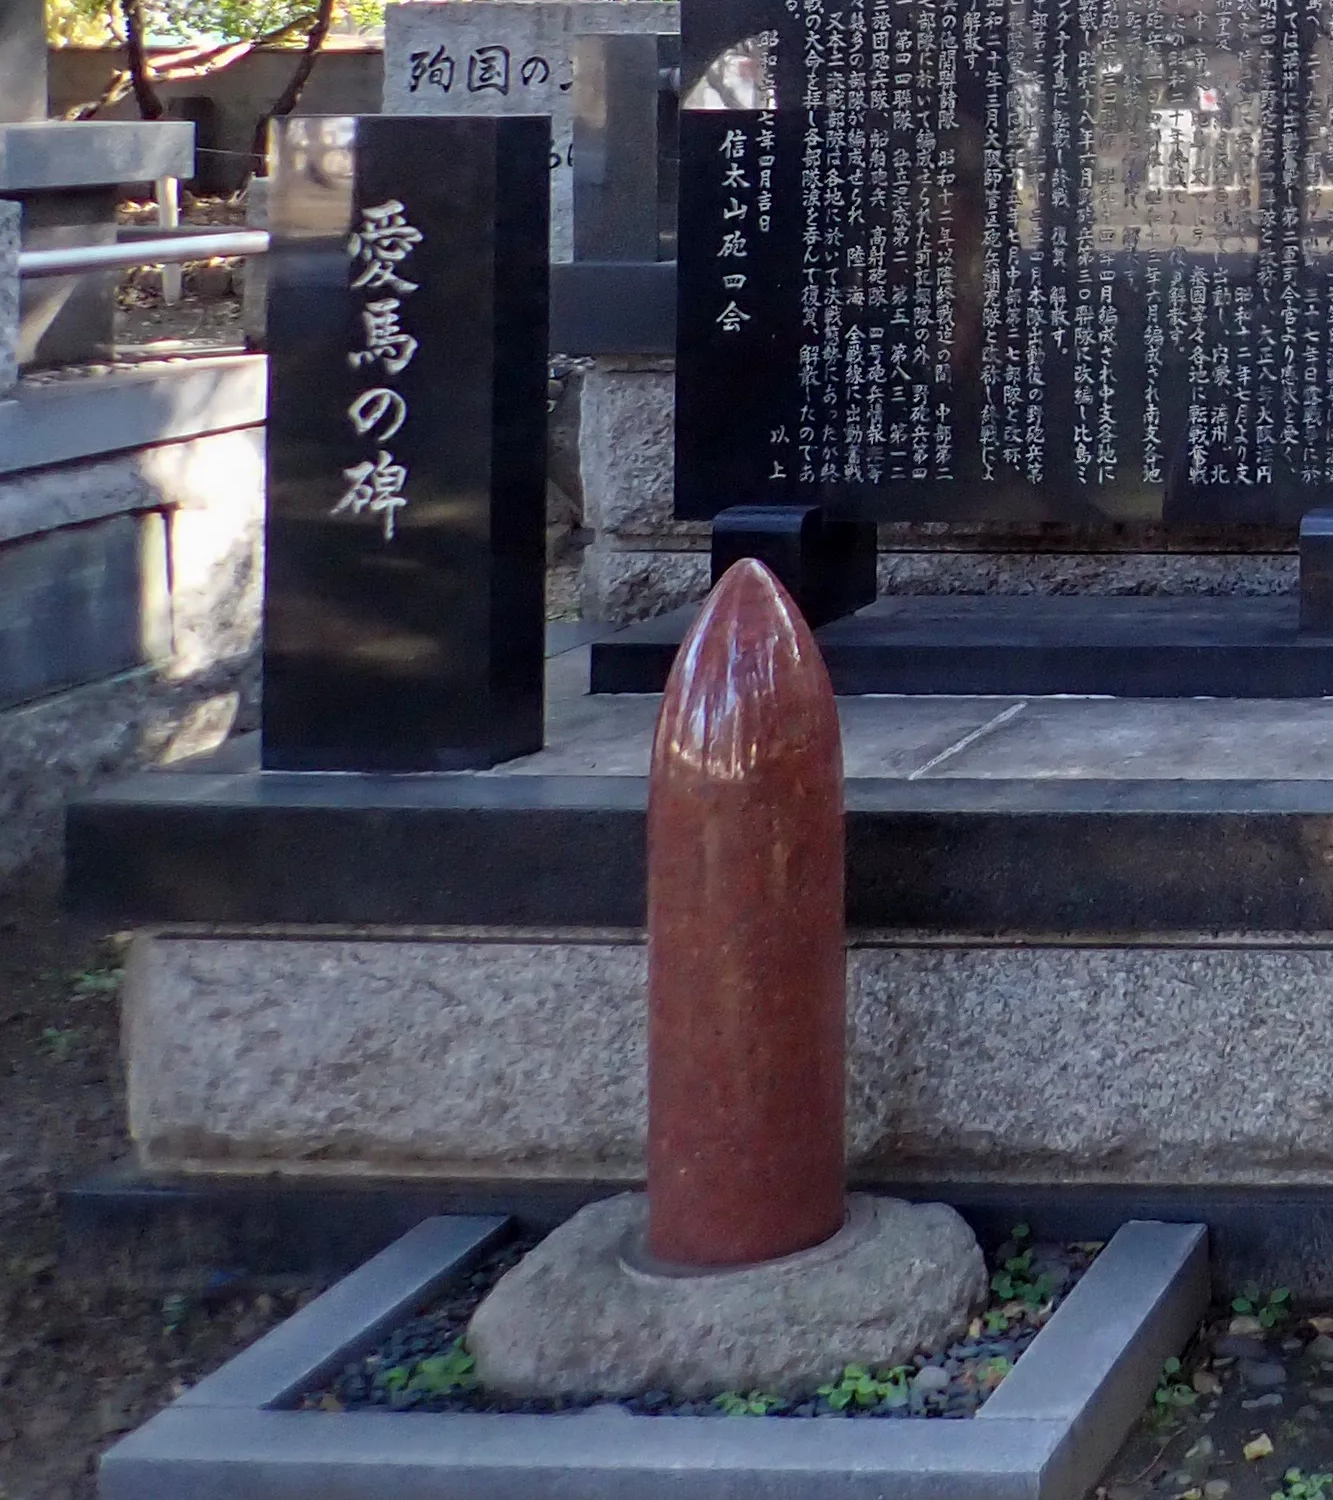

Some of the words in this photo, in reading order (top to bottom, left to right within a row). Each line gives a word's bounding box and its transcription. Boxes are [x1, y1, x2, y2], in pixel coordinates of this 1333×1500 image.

[408, 44, 574, 96] 殉国の
[715, 129, 751, 334] 信太山砲四会
[330, 198, 424, 542] 愛馬の碑
